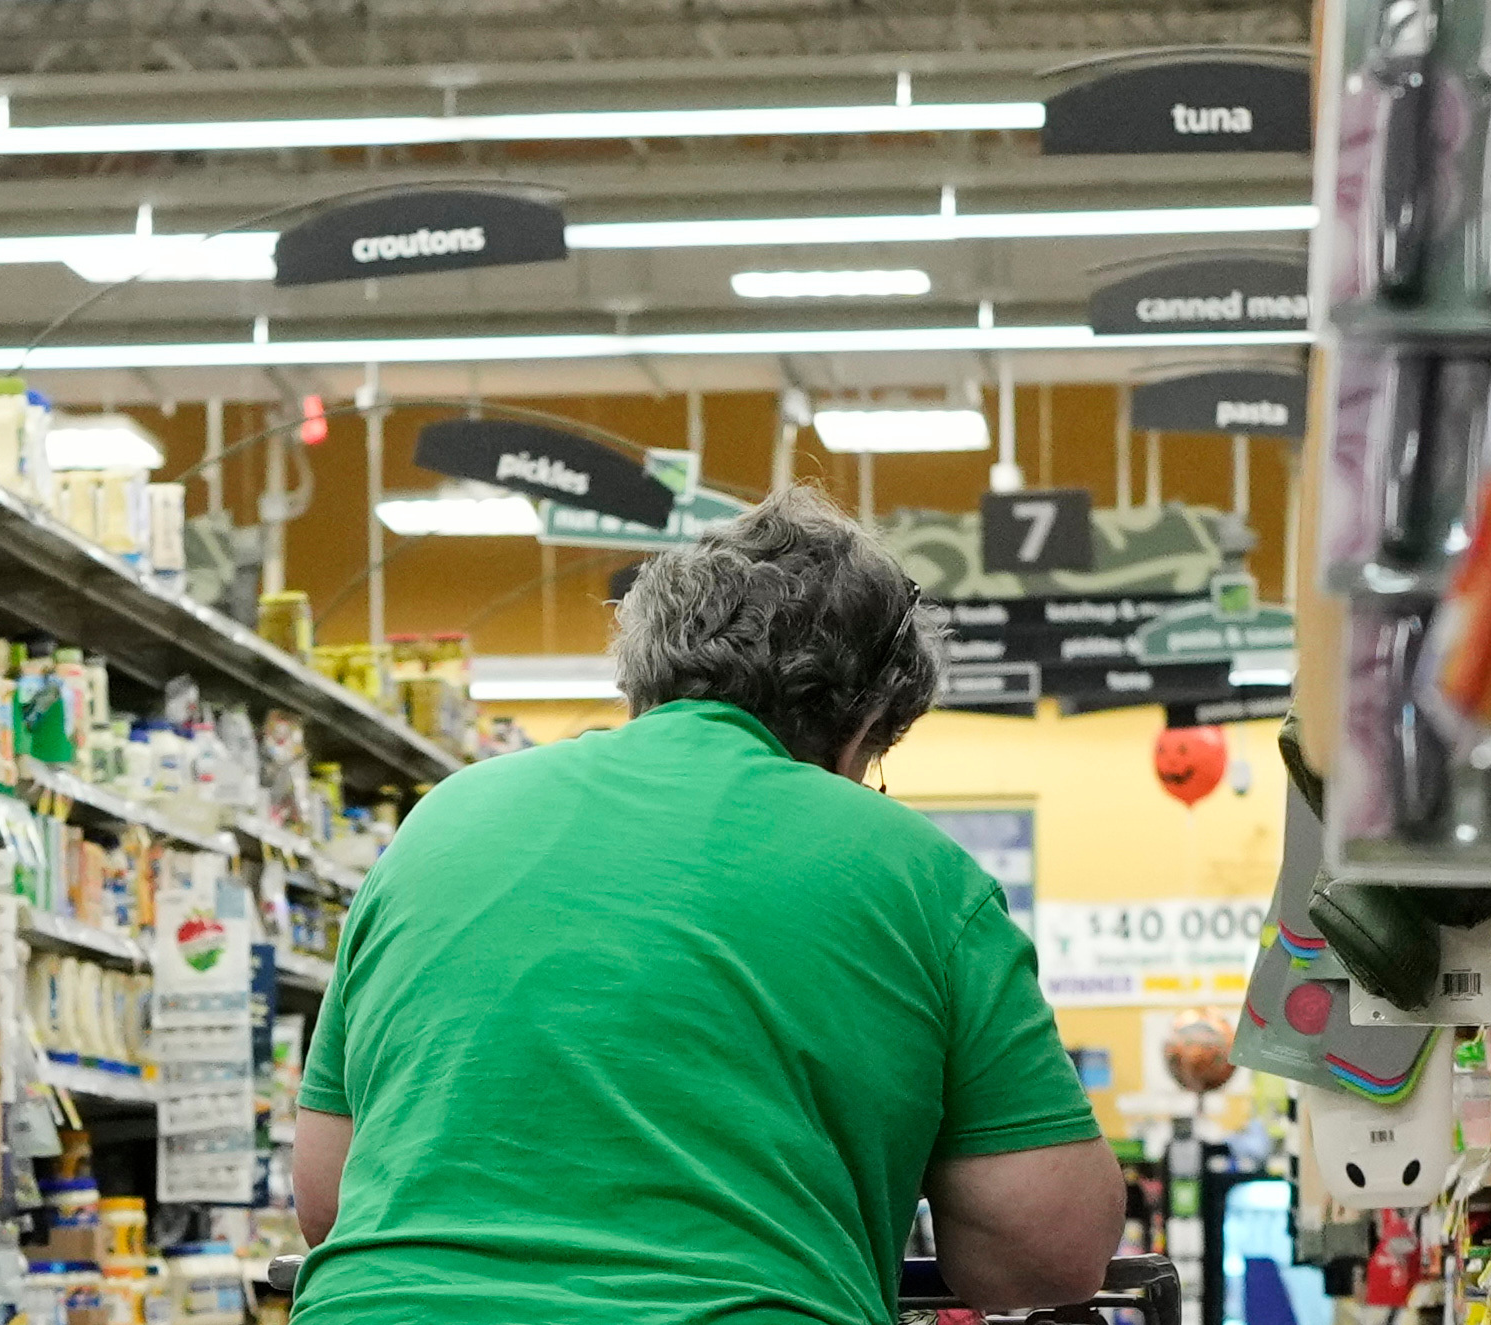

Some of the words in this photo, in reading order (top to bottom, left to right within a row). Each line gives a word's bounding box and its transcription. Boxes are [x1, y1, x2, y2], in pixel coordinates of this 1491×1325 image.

[1172, 103, 1253, 134] tuna
[352, 225, 486, 262] croutons
[1136, 290, 1243, 322] canned
[1216, 401, 1288, 429] pasta
[497, 453, 590, 496] pickles
[1013, 502, 1056, 562] 7
